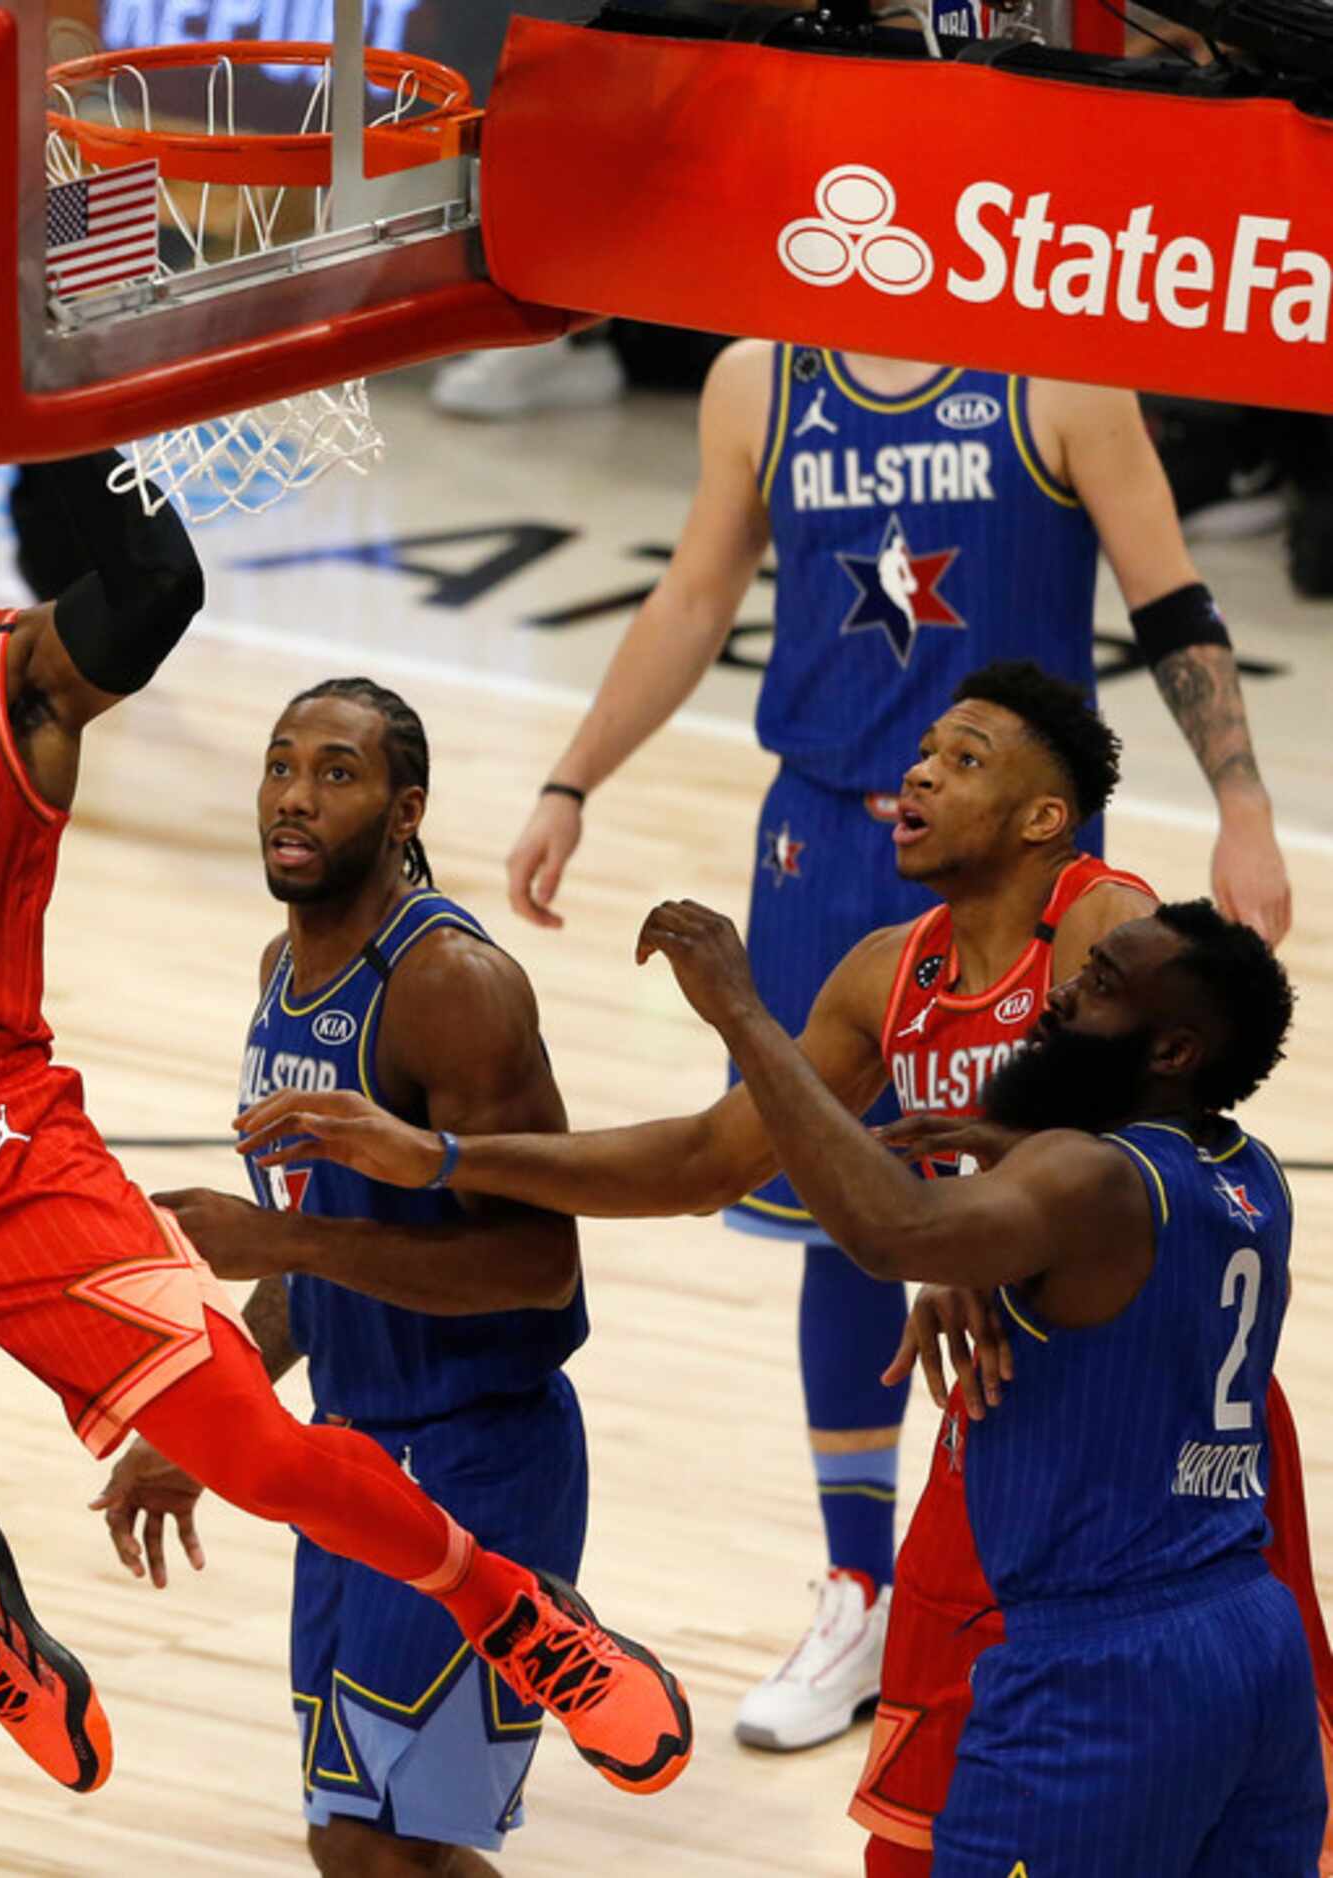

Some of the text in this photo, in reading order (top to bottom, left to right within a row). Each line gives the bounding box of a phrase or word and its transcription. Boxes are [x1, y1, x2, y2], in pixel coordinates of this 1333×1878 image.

[791, 441, 995, 512] ALL-STAR
[318, 1016, 348, 1038] KIA
[1213, 1247, 1262, 1431] 2
[1171, 1440, 1266, 1499] HARDEN
